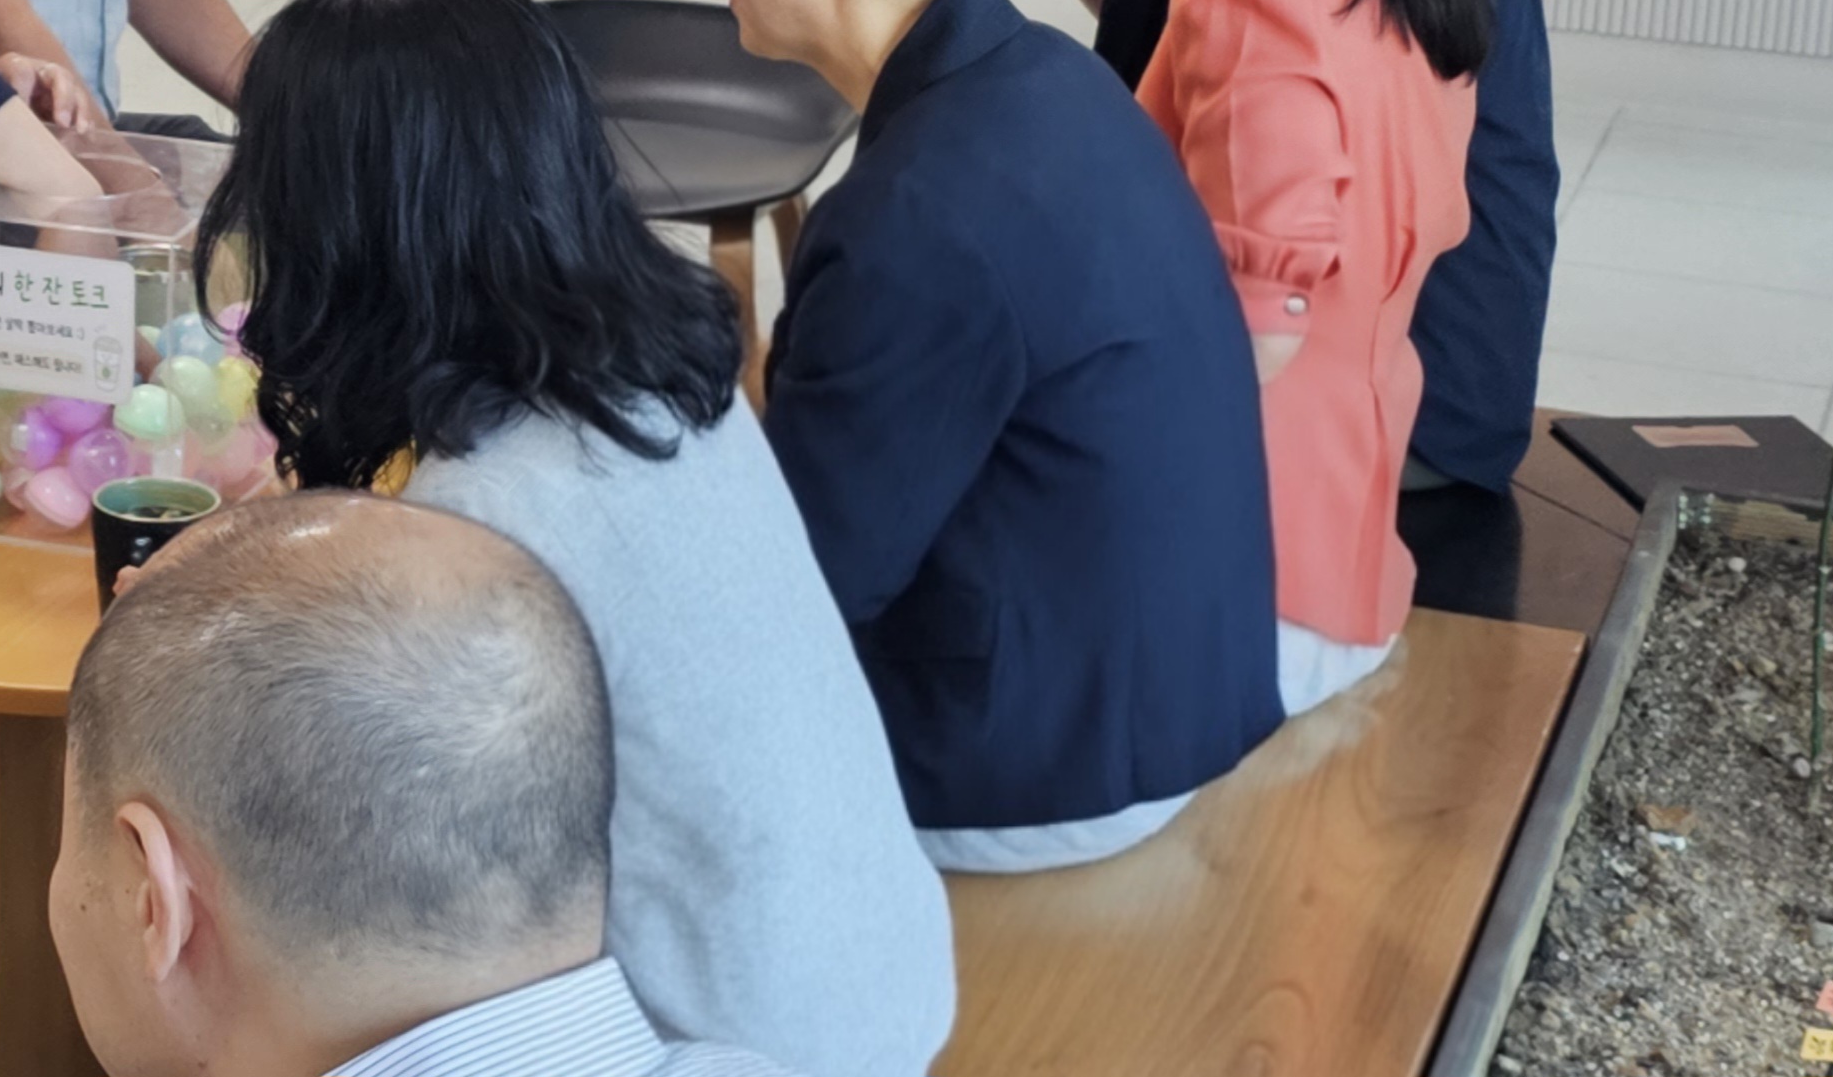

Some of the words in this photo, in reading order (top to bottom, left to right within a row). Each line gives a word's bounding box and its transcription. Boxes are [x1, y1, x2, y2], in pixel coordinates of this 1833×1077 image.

[13, 270, 34, 303] 한
[41, 276, 63, 306] 잔
[70, 280, 110, 309] 토크
